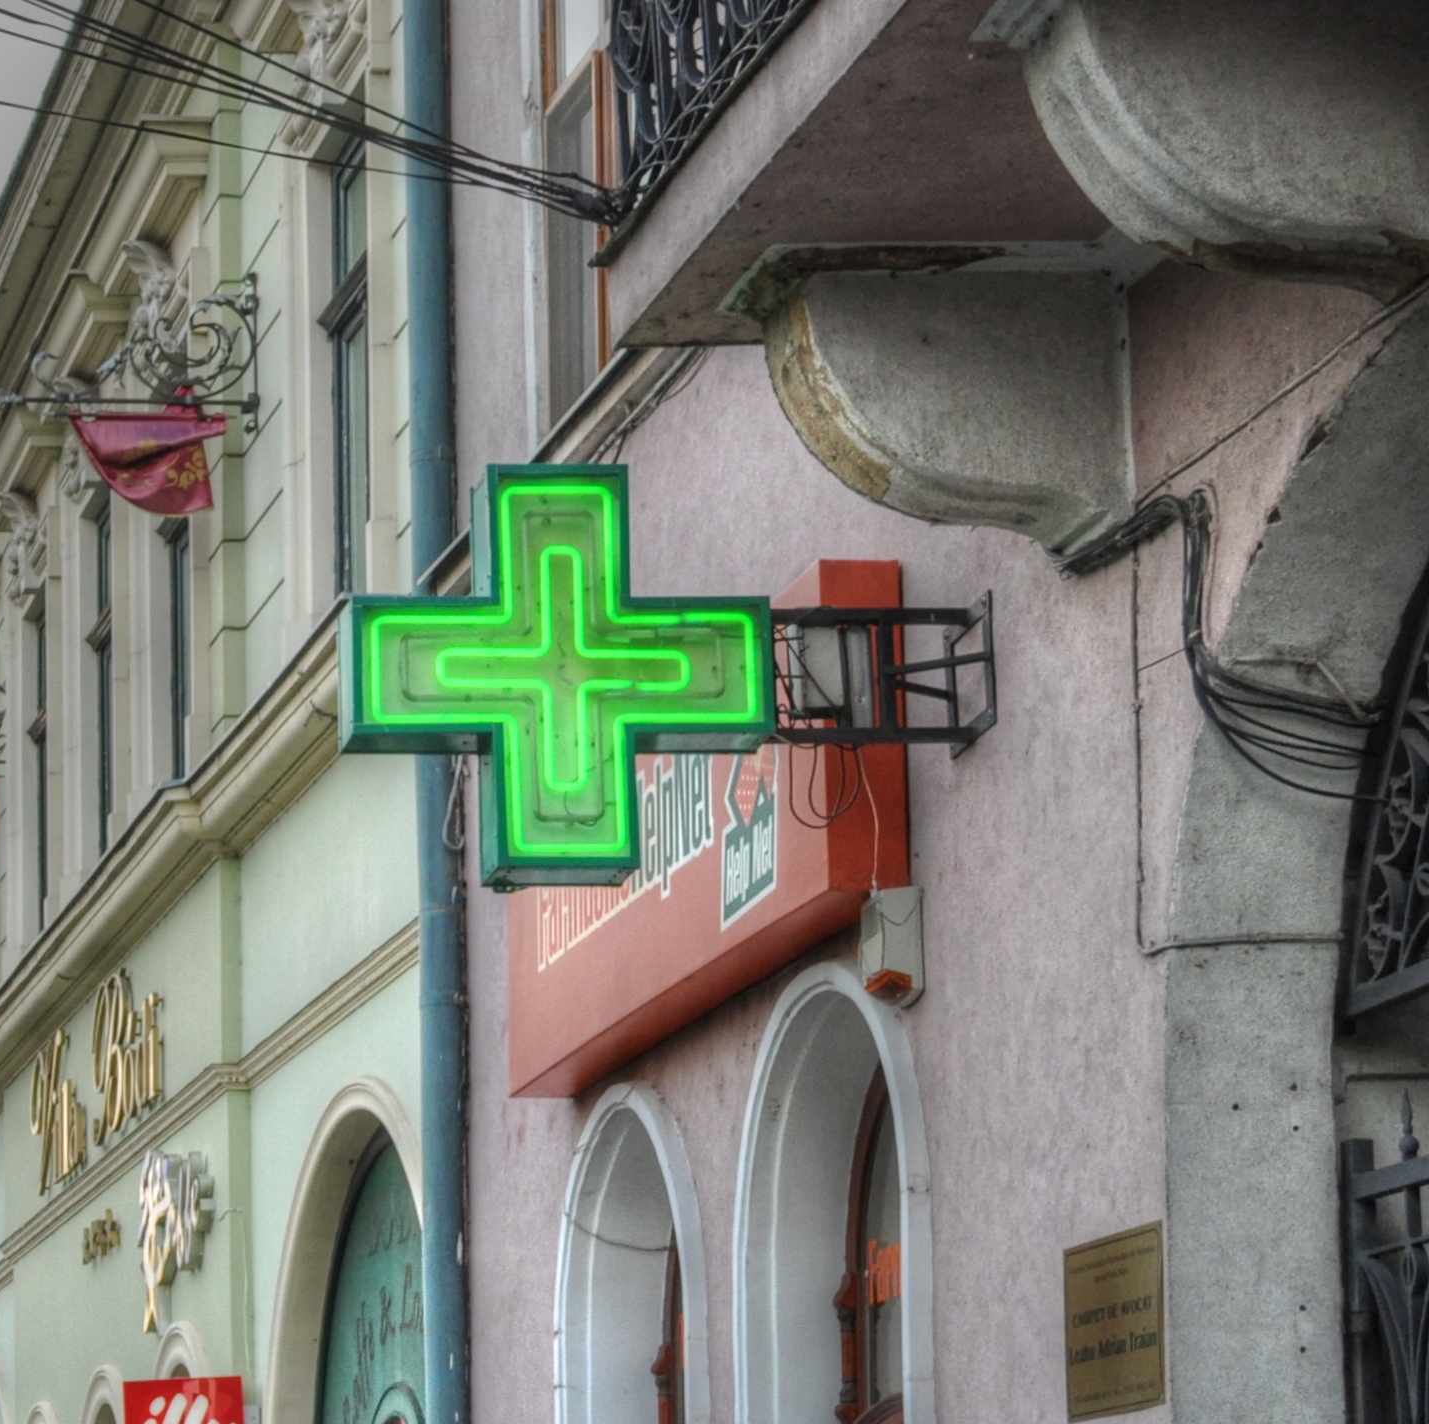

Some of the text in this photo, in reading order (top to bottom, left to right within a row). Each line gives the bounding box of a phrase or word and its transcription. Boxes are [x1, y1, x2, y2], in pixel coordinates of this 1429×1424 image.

[726, 815, 773, 907] Help Net
[30, 1029, 87, 1196] Vila
